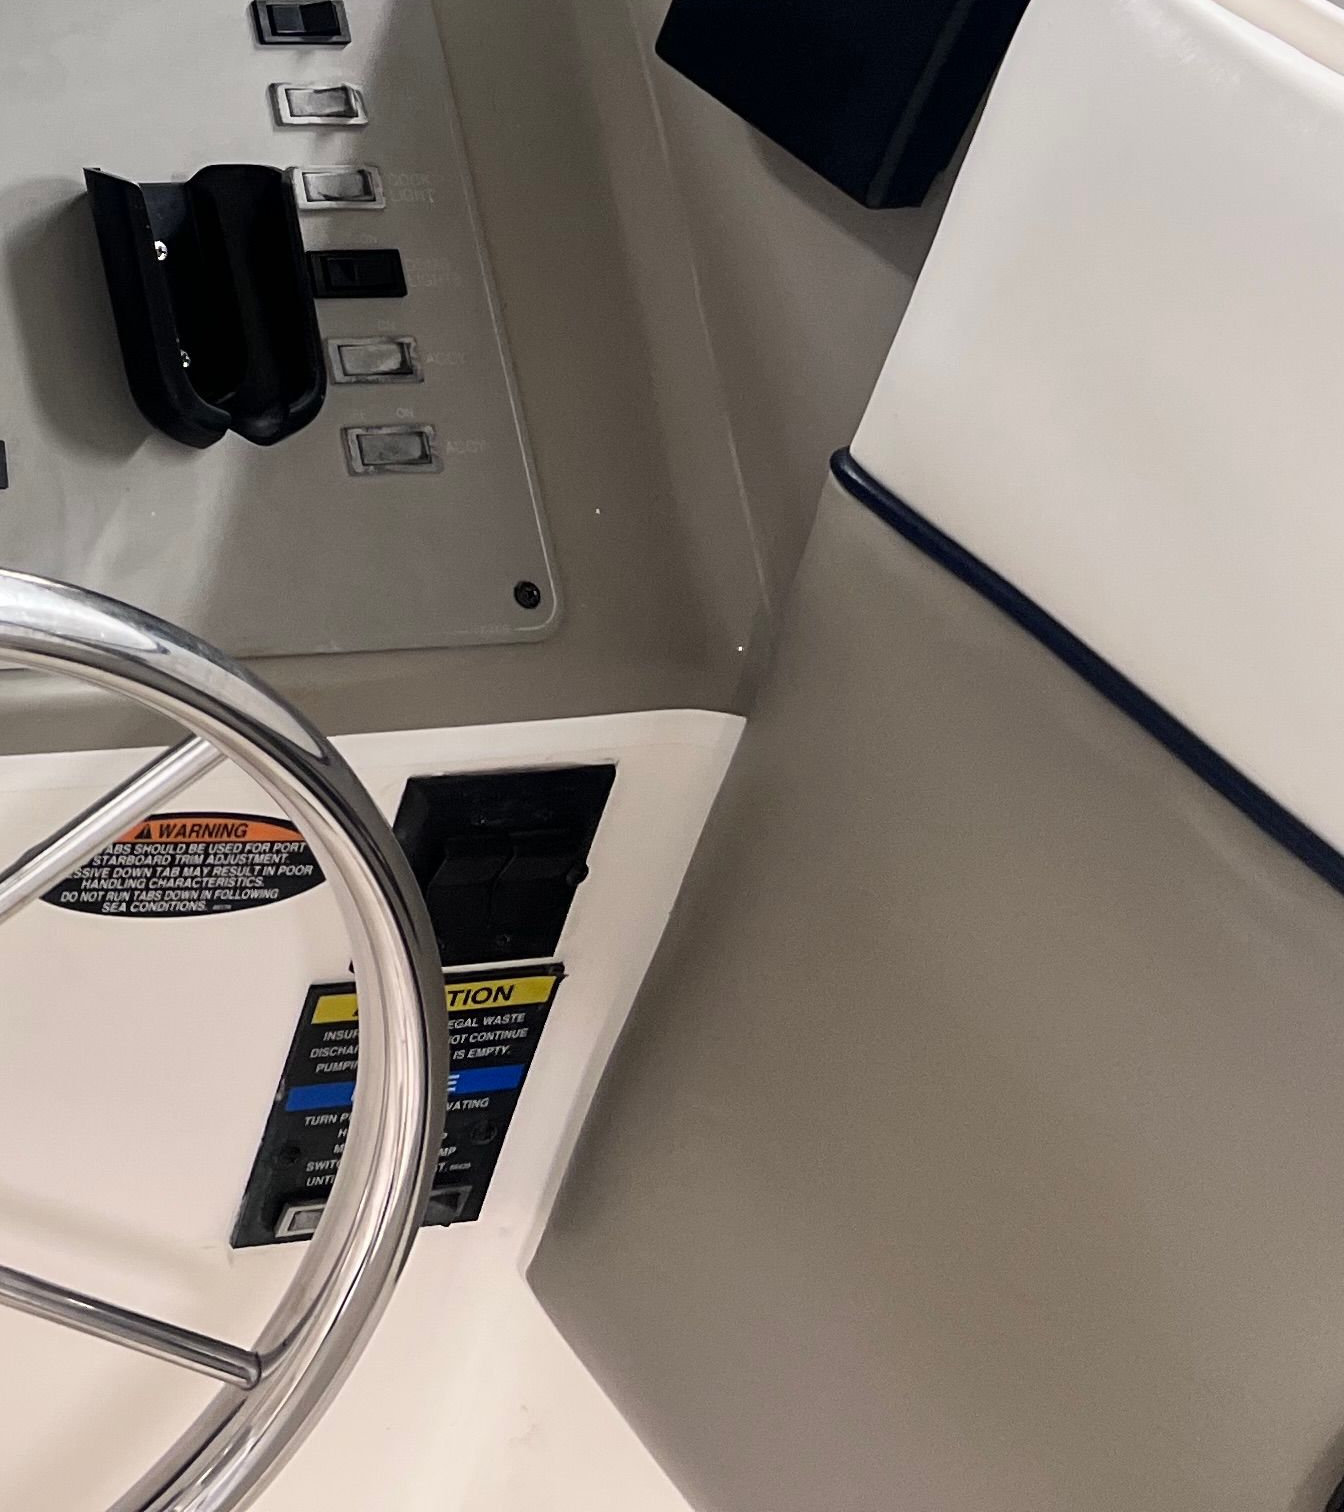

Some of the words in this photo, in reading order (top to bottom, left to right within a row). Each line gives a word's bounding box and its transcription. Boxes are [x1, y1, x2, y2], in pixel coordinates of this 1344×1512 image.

[158, 823, 249, 839] WARNING
[104, 843, 132, 855] ABS
[133, 843, 186, 854] SHOULD
[188, 843, 207, 854] BE
[208, 843, 243, 854] USED
[244, 842, 271, 853] FOR
[272, 842, 306, 853] PORT
[92, 854, 172, 866] STARBOARD
[174, 854, 204, 865] TRIM
[112, 867, 153, 878] DOWN
[155, 866, 181, 877] TAB
[182, 866, 212, 877] MAY
[211, 866, 262, 876] RESULT
[277, 864, 314, 876] POOR
[80, 878, 146, 889] HANDLING
[60, 891, 78, 902] DO
[79, 891, 105, 902] NOT
[105, 890, 130, 901] RUN
[132, 890, 162, 901] TABS
[164, 890, 200, 901] DOWN
[213, 888, 280, 900] FOLLOWING
[101, 902, 127, 913] SEA
[447, 984, 515, 1007] TION
[483, 1012, 526, 1026] WASTE
[469, 1027, 529, 1043] CONTINUE
[304, 1114, 338, 1127] TURN
